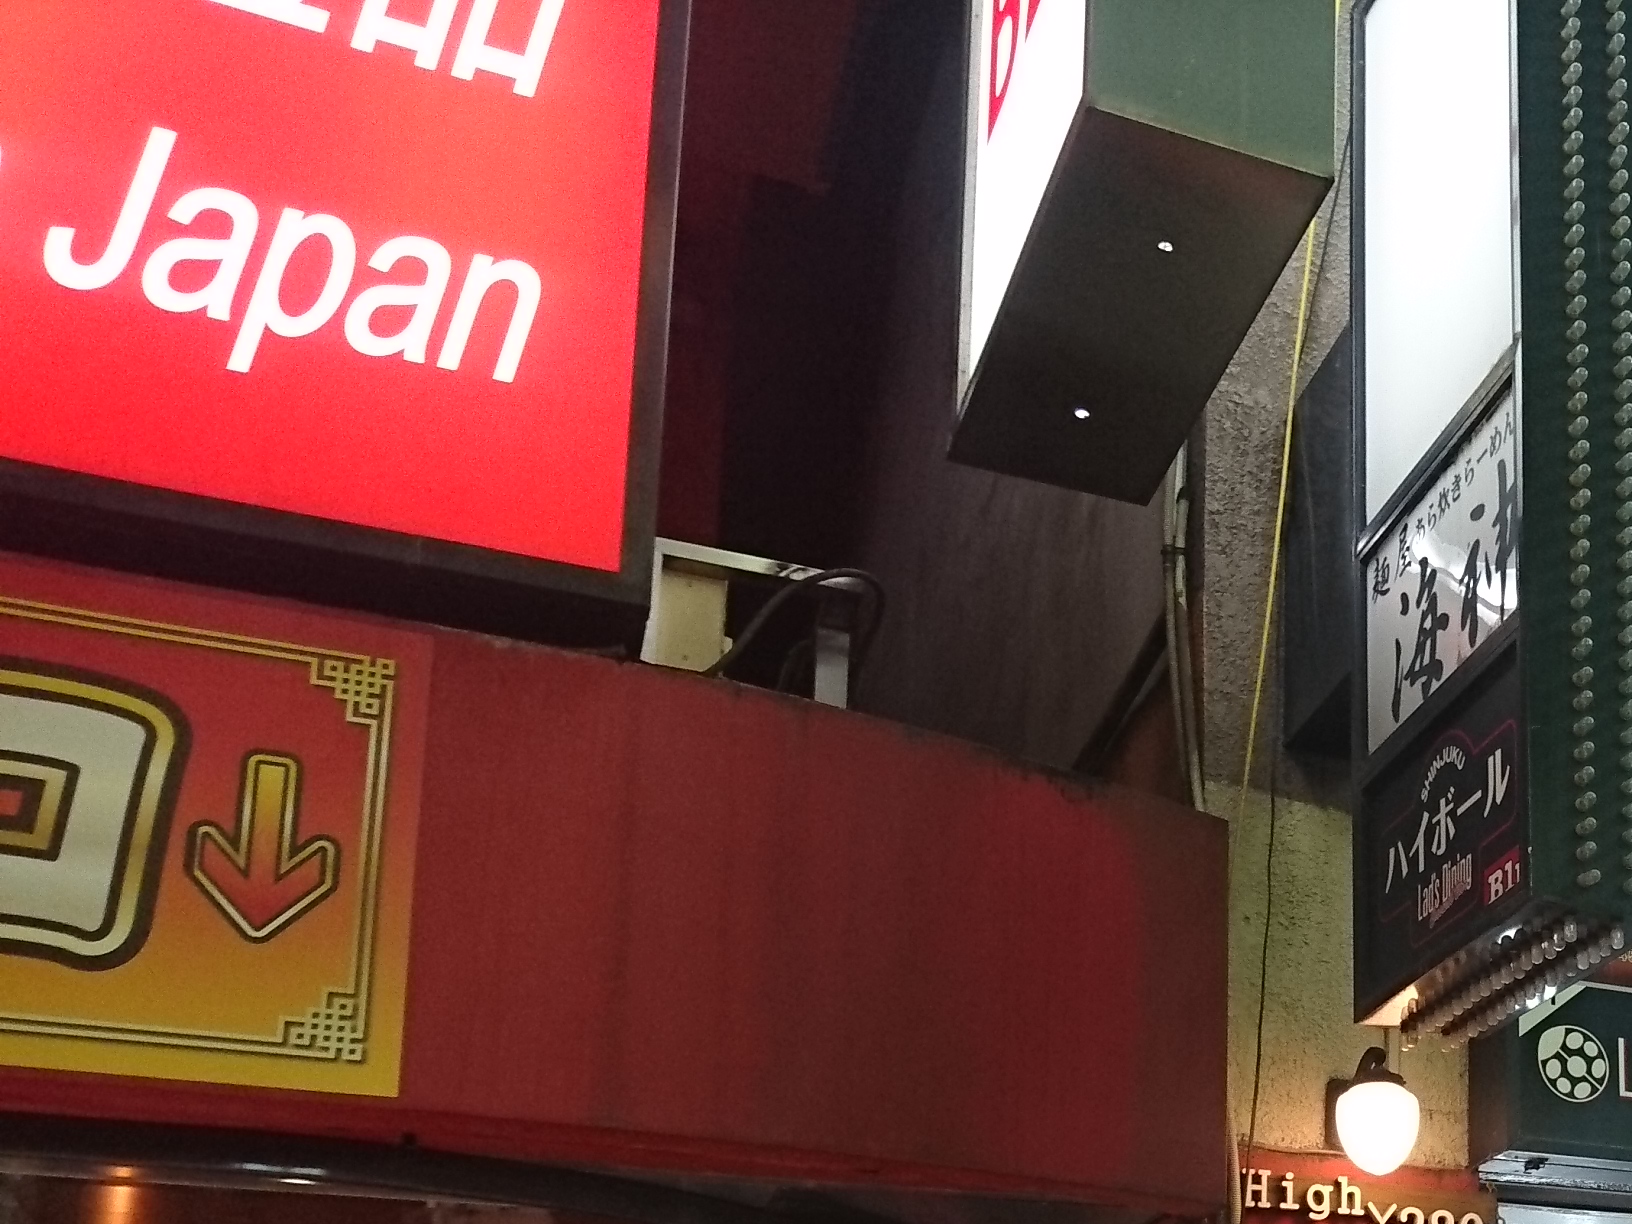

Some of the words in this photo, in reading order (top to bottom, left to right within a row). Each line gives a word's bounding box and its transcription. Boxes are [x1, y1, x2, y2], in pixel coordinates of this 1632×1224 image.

[43, 126, 542, 384] Japan
[1385, 748, 1510, 894] ハイボール
[1421, 746, 1465, 803] SHINJUKU
[1242, 1168, 1365, 1220] High
